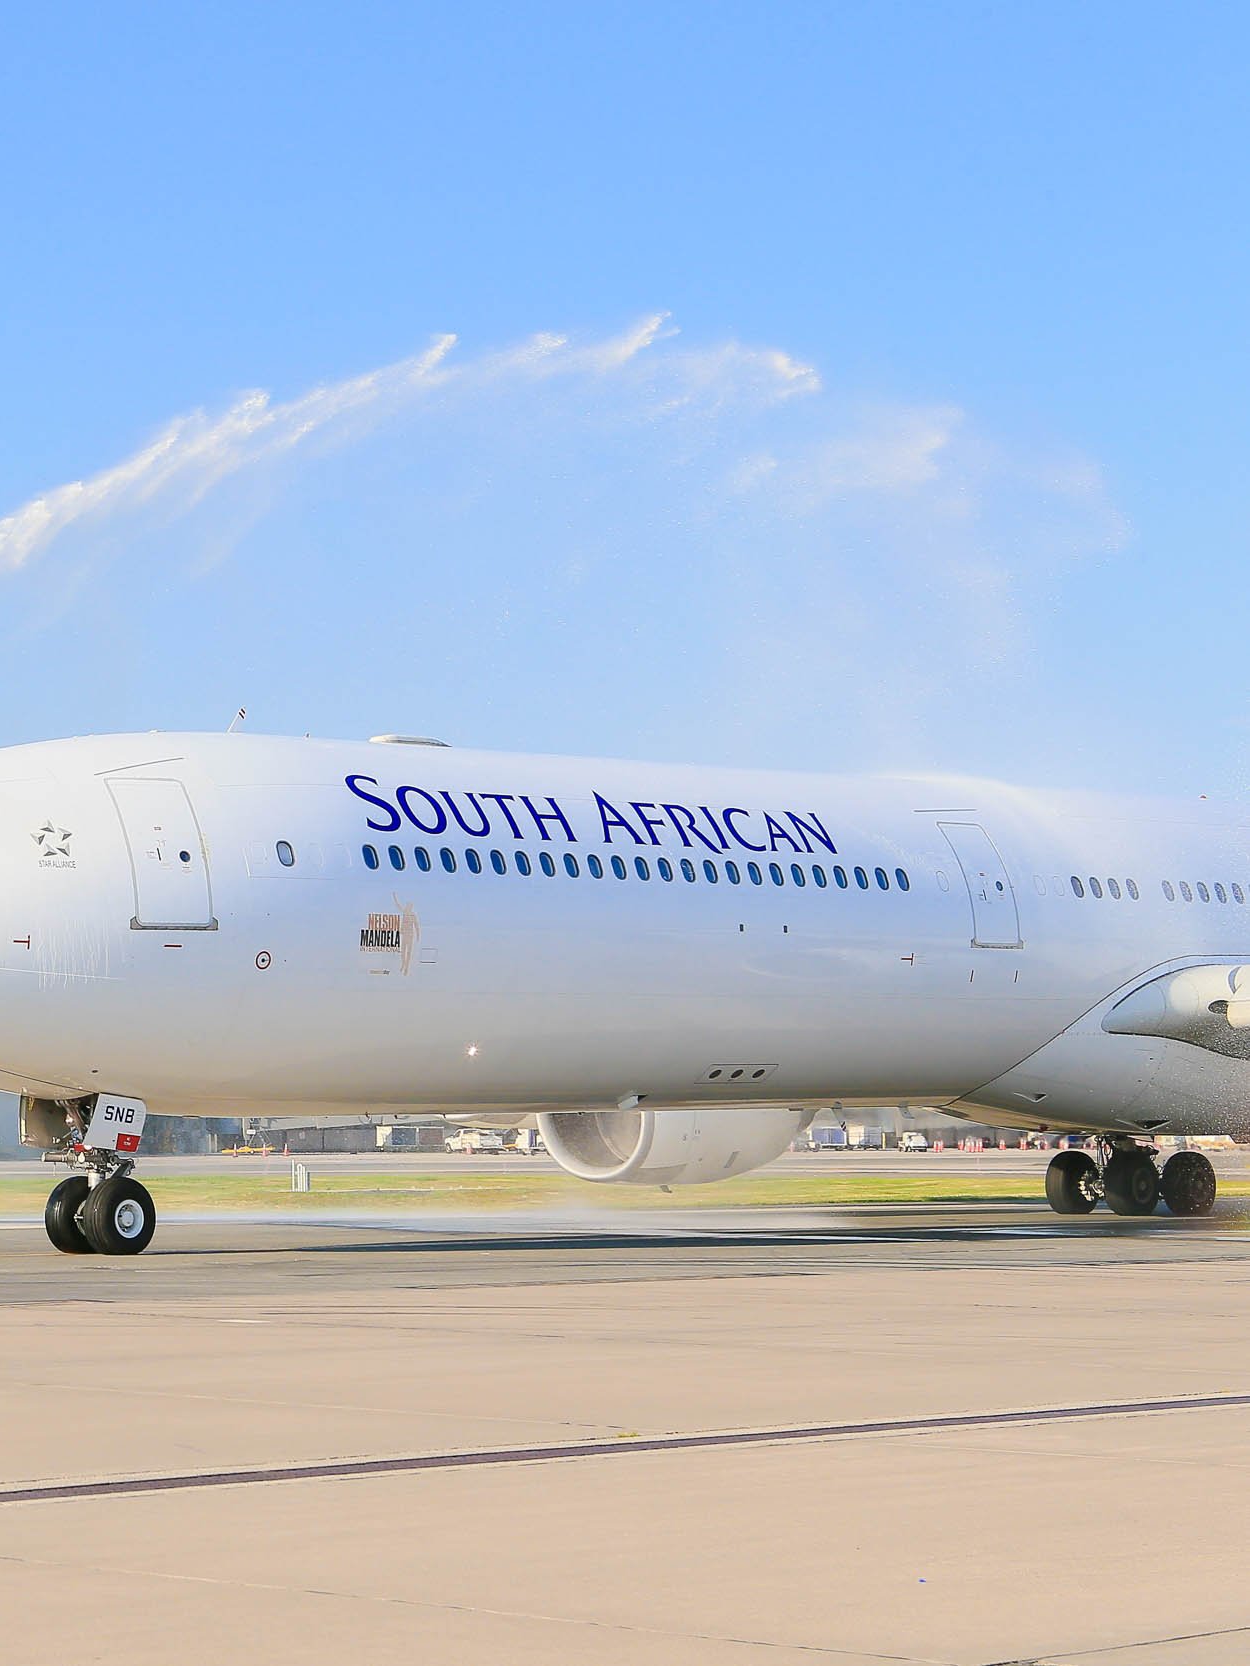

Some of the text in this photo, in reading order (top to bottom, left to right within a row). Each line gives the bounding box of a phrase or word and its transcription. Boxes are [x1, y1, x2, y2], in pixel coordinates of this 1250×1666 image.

[345, 774, 838, 855] SOUTH AFRICAN
[368, 913, 400, 931] NELSON
[360, 929, 401, 947] MANDELA
[104, 1105, 135, 1124] SNB
